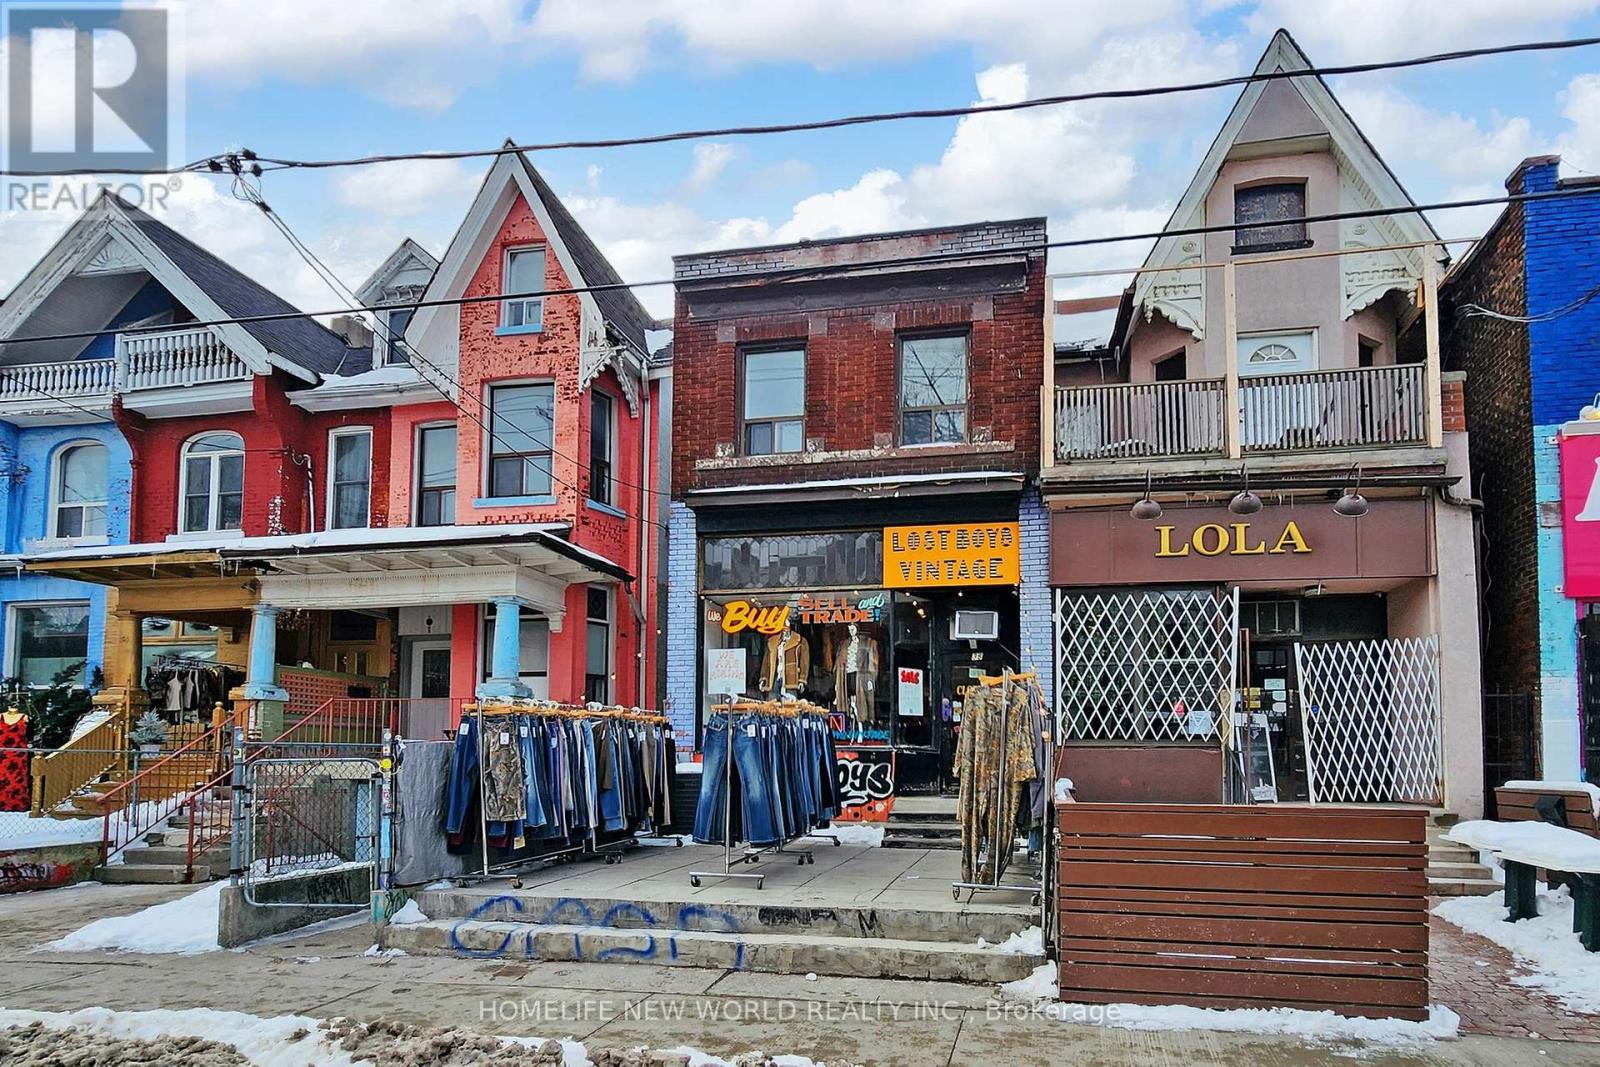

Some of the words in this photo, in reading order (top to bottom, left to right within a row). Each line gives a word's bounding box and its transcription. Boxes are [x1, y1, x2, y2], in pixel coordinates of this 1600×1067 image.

[892, 530, 951, 552] LOST
[956, 527, 1013, 549] BOYS
[1154, 521, 1312, 557] LOLA
[899, 558, 1003, 581] VINTAGE
[797, 596, 855, 610] SELL
[858, 593, 886, 610] and
[707, 609, 722, 622] We
[721, 600, 791, 635] Buy
[799, 609, 880, 625] TRADE!
